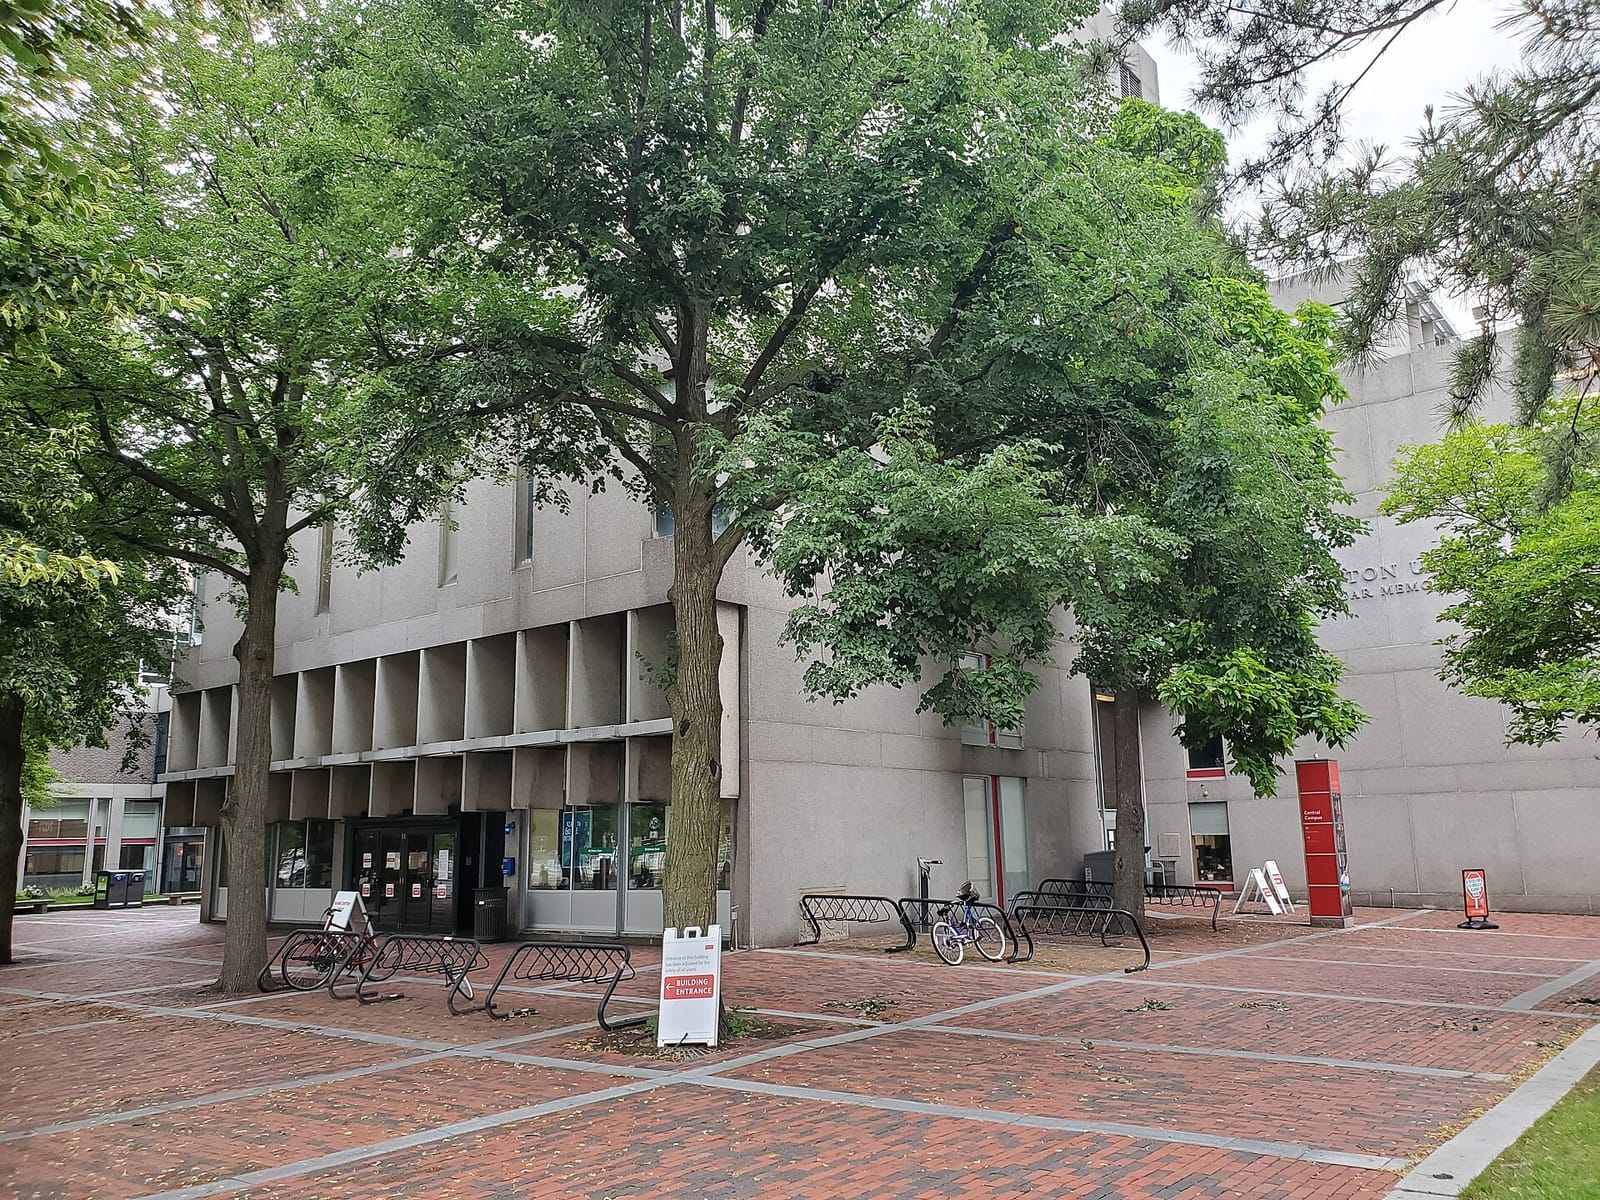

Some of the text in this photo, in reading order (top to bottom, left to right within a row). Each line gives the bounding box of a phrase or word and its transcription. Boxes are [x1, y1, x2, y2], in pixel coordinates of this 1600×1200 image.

[1345, 564, 1397, 583] TON
[1380, 580, 1431, 597] MEMO
[676, 979, 708, 987] BUILDING
[676, 987, 712, 995] ENTRANCE
